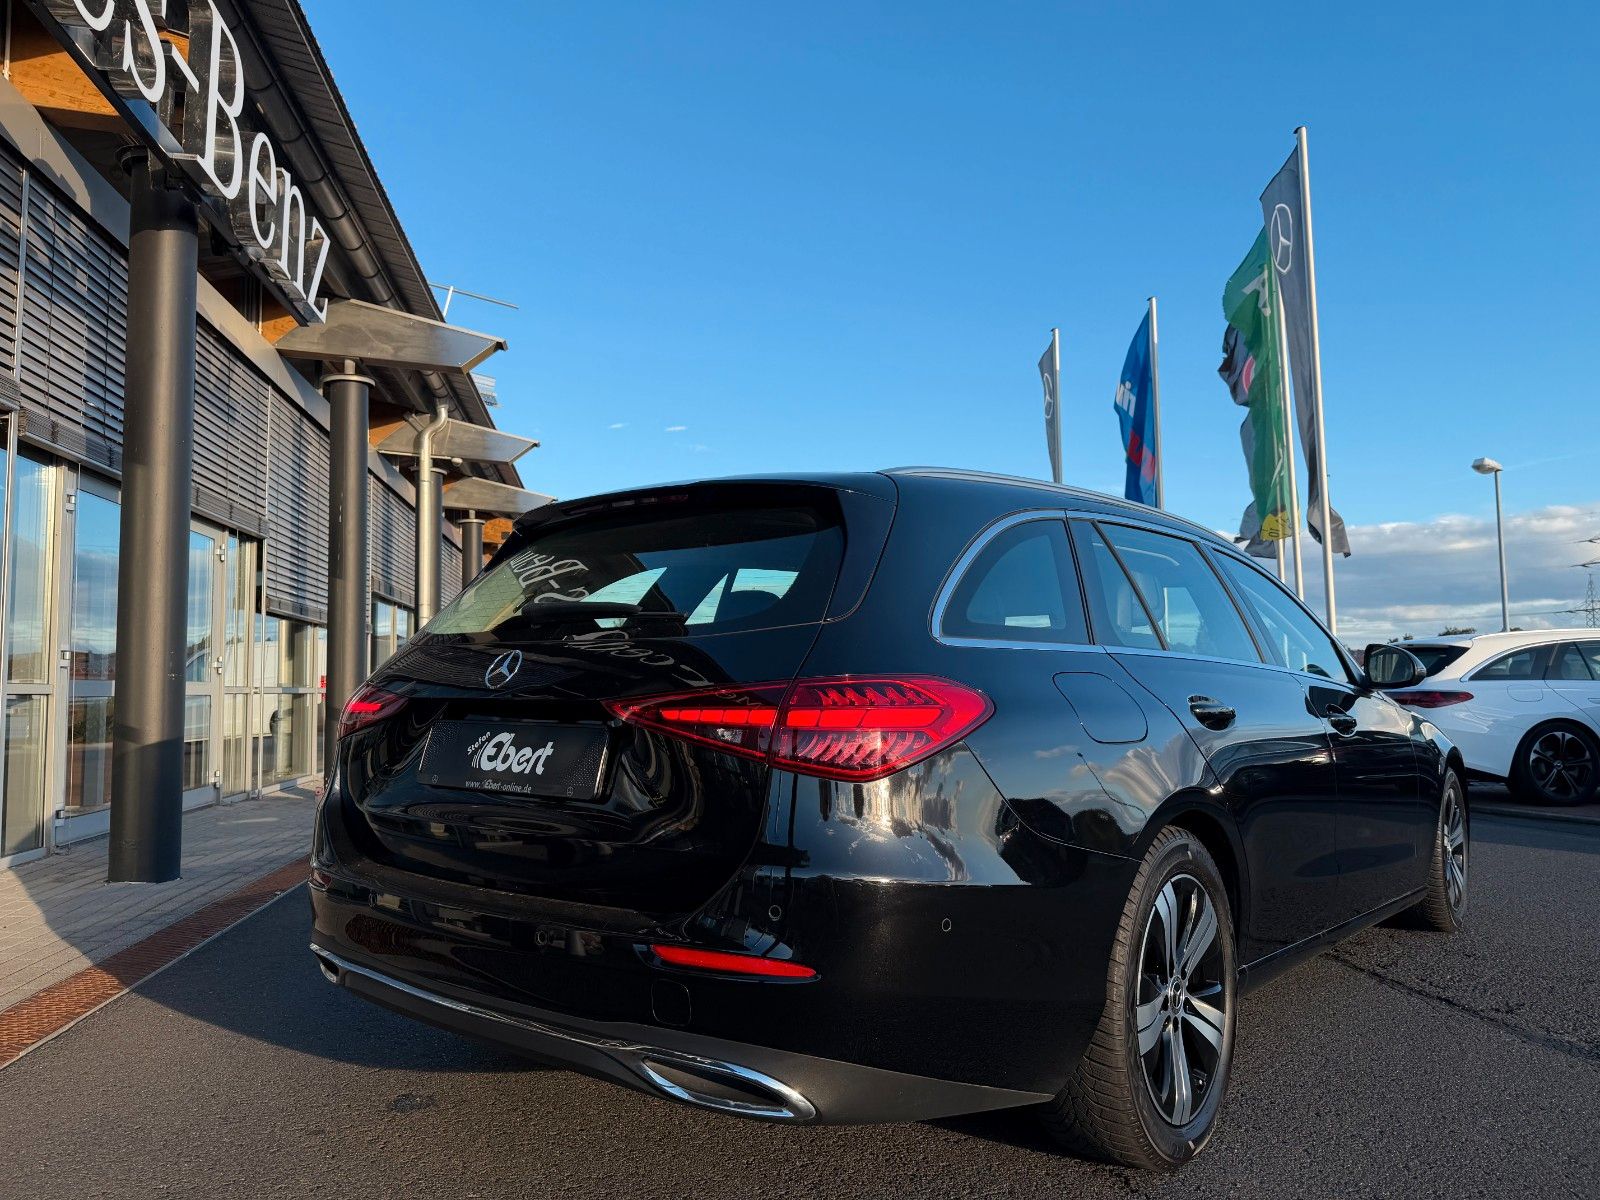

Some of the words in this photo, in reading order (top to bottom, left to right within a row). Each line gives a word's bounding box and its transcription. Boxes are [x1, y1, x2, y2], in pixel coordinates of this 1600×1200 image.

[74, 0, 330, 324] s-Benz
[467, 731, 491, 755] Stefan
[480, 732, 554, 775] Ebert
